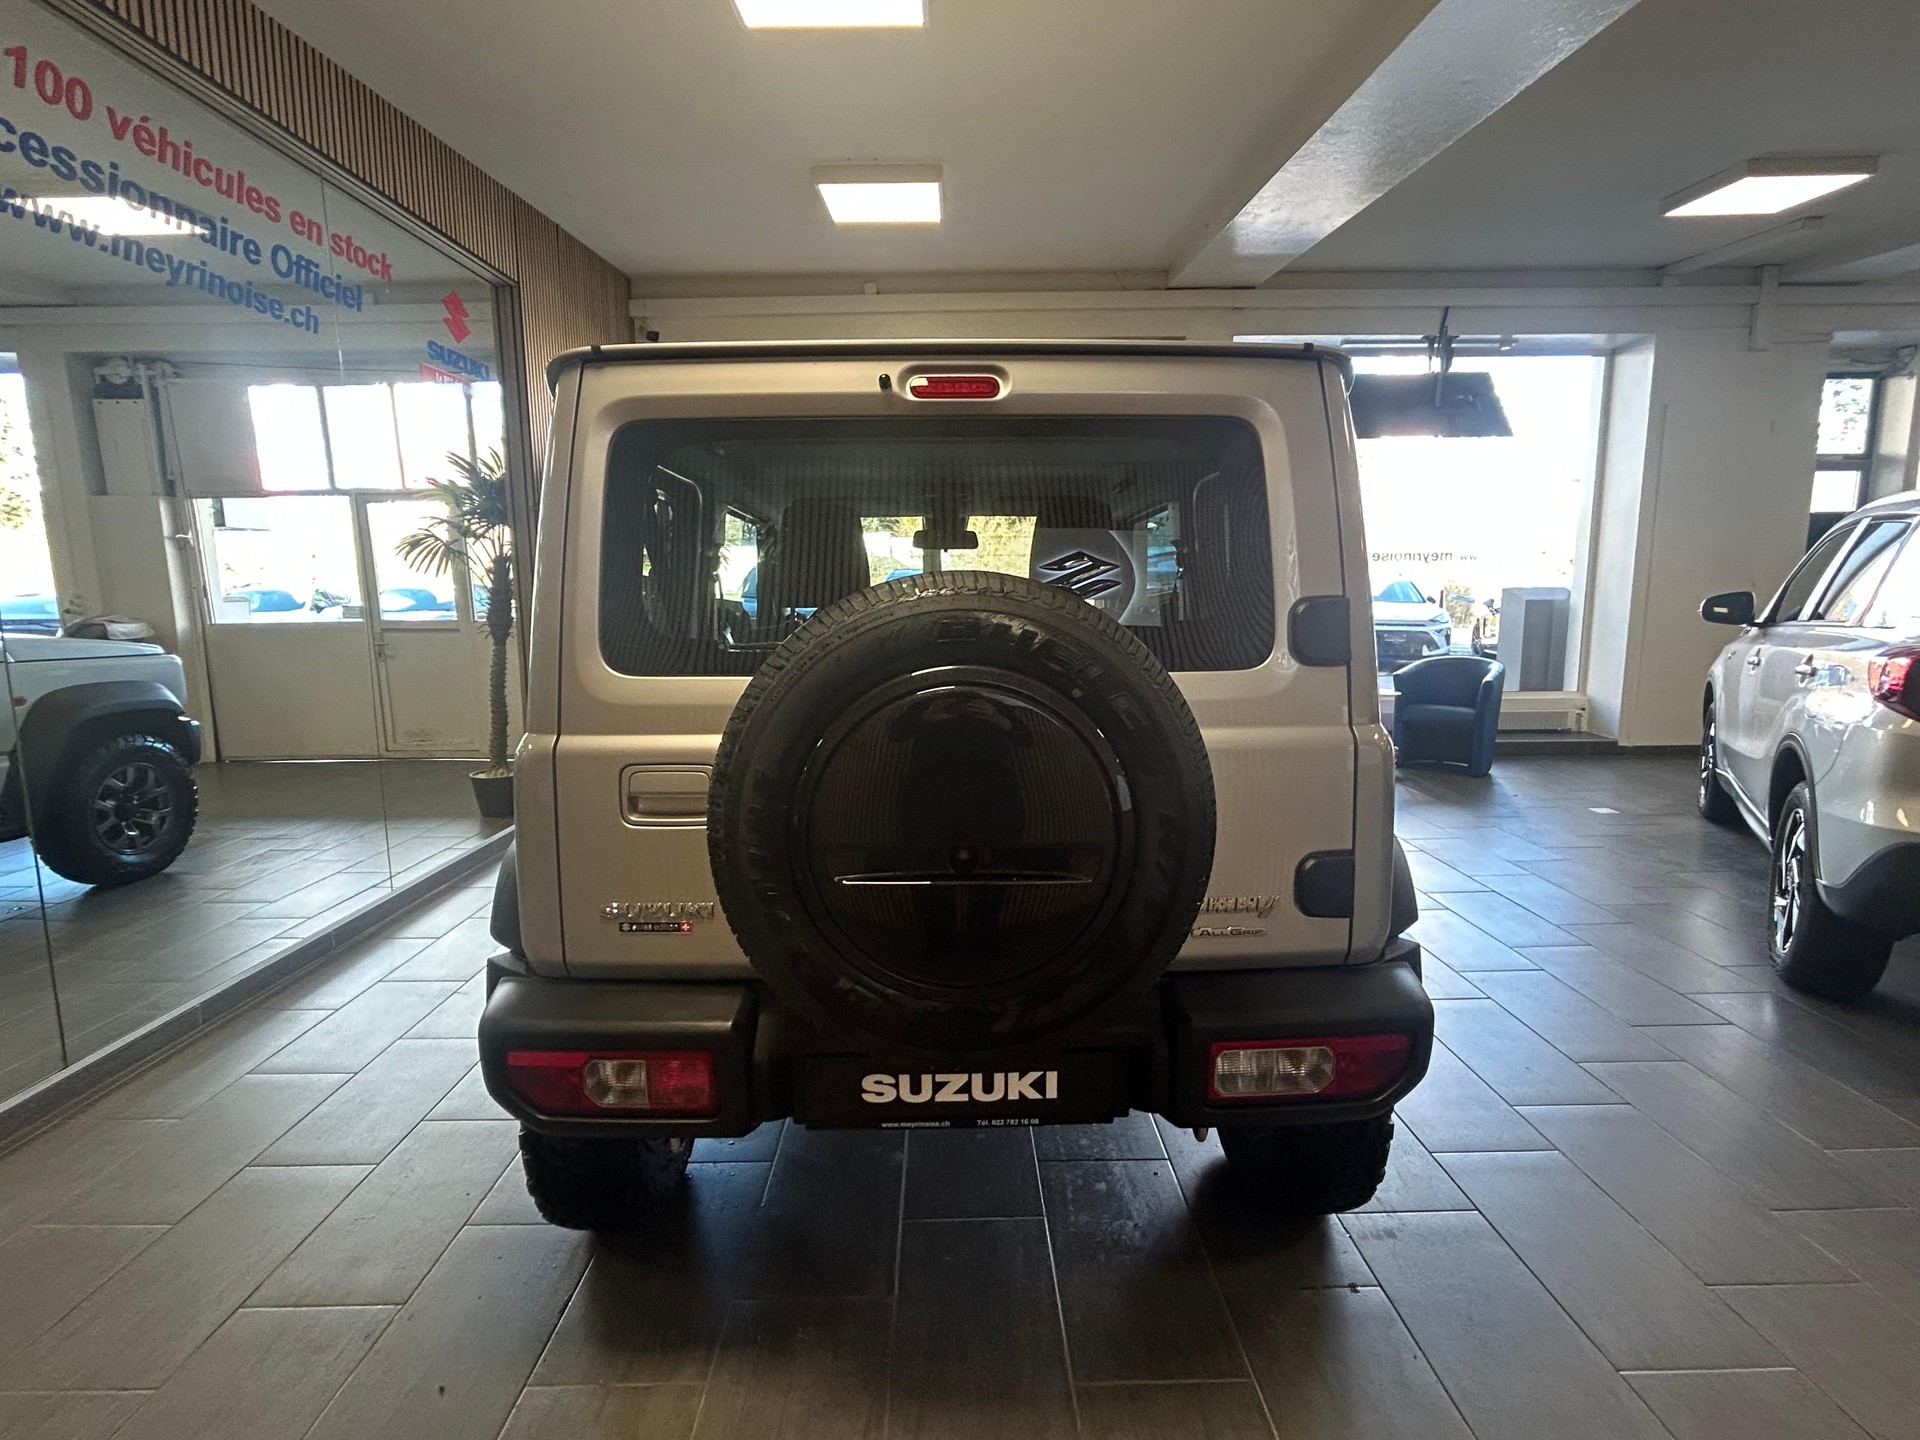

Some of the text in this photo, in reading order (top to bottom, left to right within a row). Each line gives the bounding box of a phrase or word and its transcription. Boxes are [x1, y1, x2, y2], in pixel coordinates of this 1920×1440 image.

[3, 45, 394, 283] 100 véhicules en stock
[271, 244, 363, 312] Officiel
[427, 340, 491, 382] SUZUKI
[861, 1070, 1058, 1104] SUZUKI
